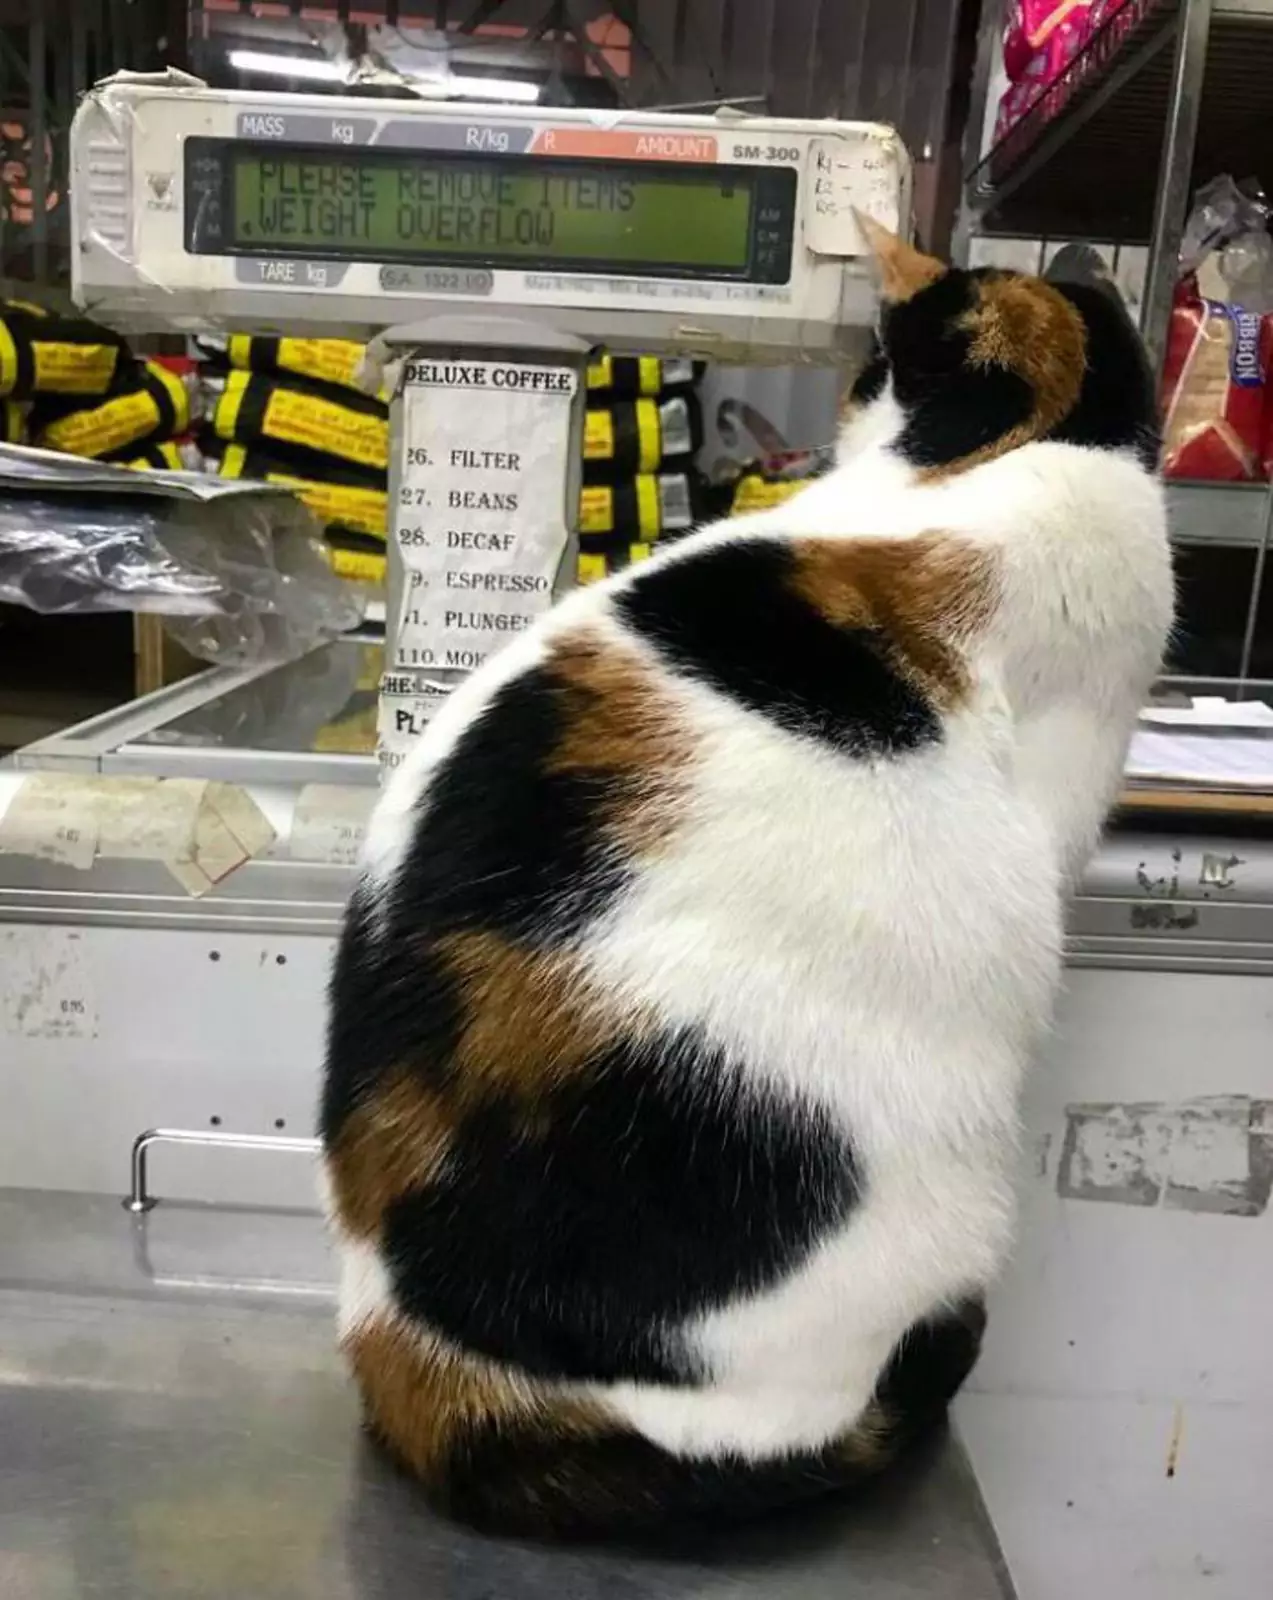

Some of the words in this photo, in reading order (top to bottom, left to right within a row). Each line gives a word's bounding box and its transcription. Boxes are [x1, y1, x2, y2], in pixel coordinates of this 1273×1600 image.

[242, 115, 285, 137] MASS
[331, 121, 354, 144] kg
[466, 127, 509, 151] R/kg
[544, 131, 556, 150] R
[635, 136, 713, 157] AMOUNT
[732, 145, 800, 161] SM-300
[260, 160, 376, 198] PLEASE
[398, 167, 516, 207] REMOVE
[540, 173, 636, 211] ITEMS
[260, 196, 377, 239] WEIGHT
[397, 203, 556, 246] OVERFLOW
[256, 262, 296, 282] TARE
[306, 263, 327, 288] kg
[404, 365, 487, 386] DELUXE
[492, 369, 572, 391] COFFEE
[451, 450, 520, 471] FILTER
[400, 488, 431, 506] 27.
[448, 490, 519, 511] BEANS
[399, 527, 430, 547] 28.
[447, 531, 516, 551] DECAF
[446, 571, 548, 593] ESPRESSO
[398, 648, 438, 665] 110.
[396, 709, 430, 735] PL
